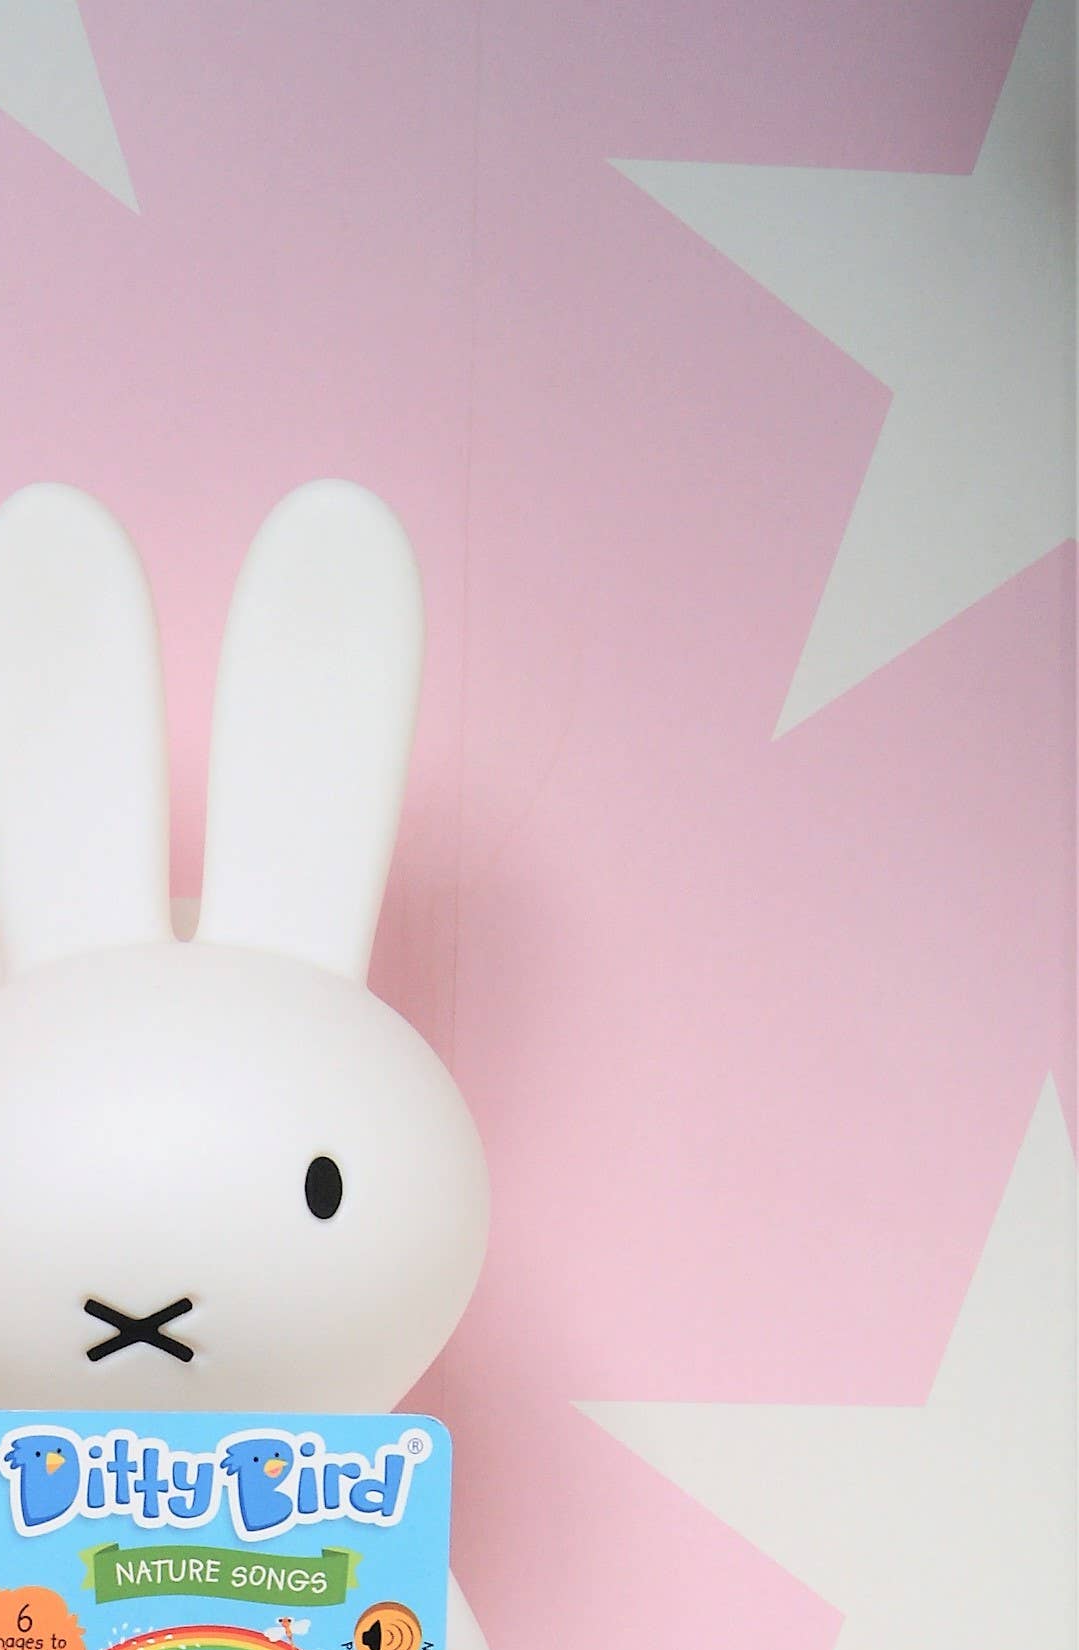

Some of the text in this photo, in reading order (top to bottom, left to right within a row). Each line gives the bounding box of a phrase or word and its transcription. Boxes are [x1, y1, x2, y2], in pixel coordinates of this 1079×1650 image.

[3, 1434, 406, 1532] Ditty Bird
[115, 1558, 329, 1595] NATURE SONGS
[17, 1603, 33, 1633] 6
[51, 1633, 67, 1650] to
